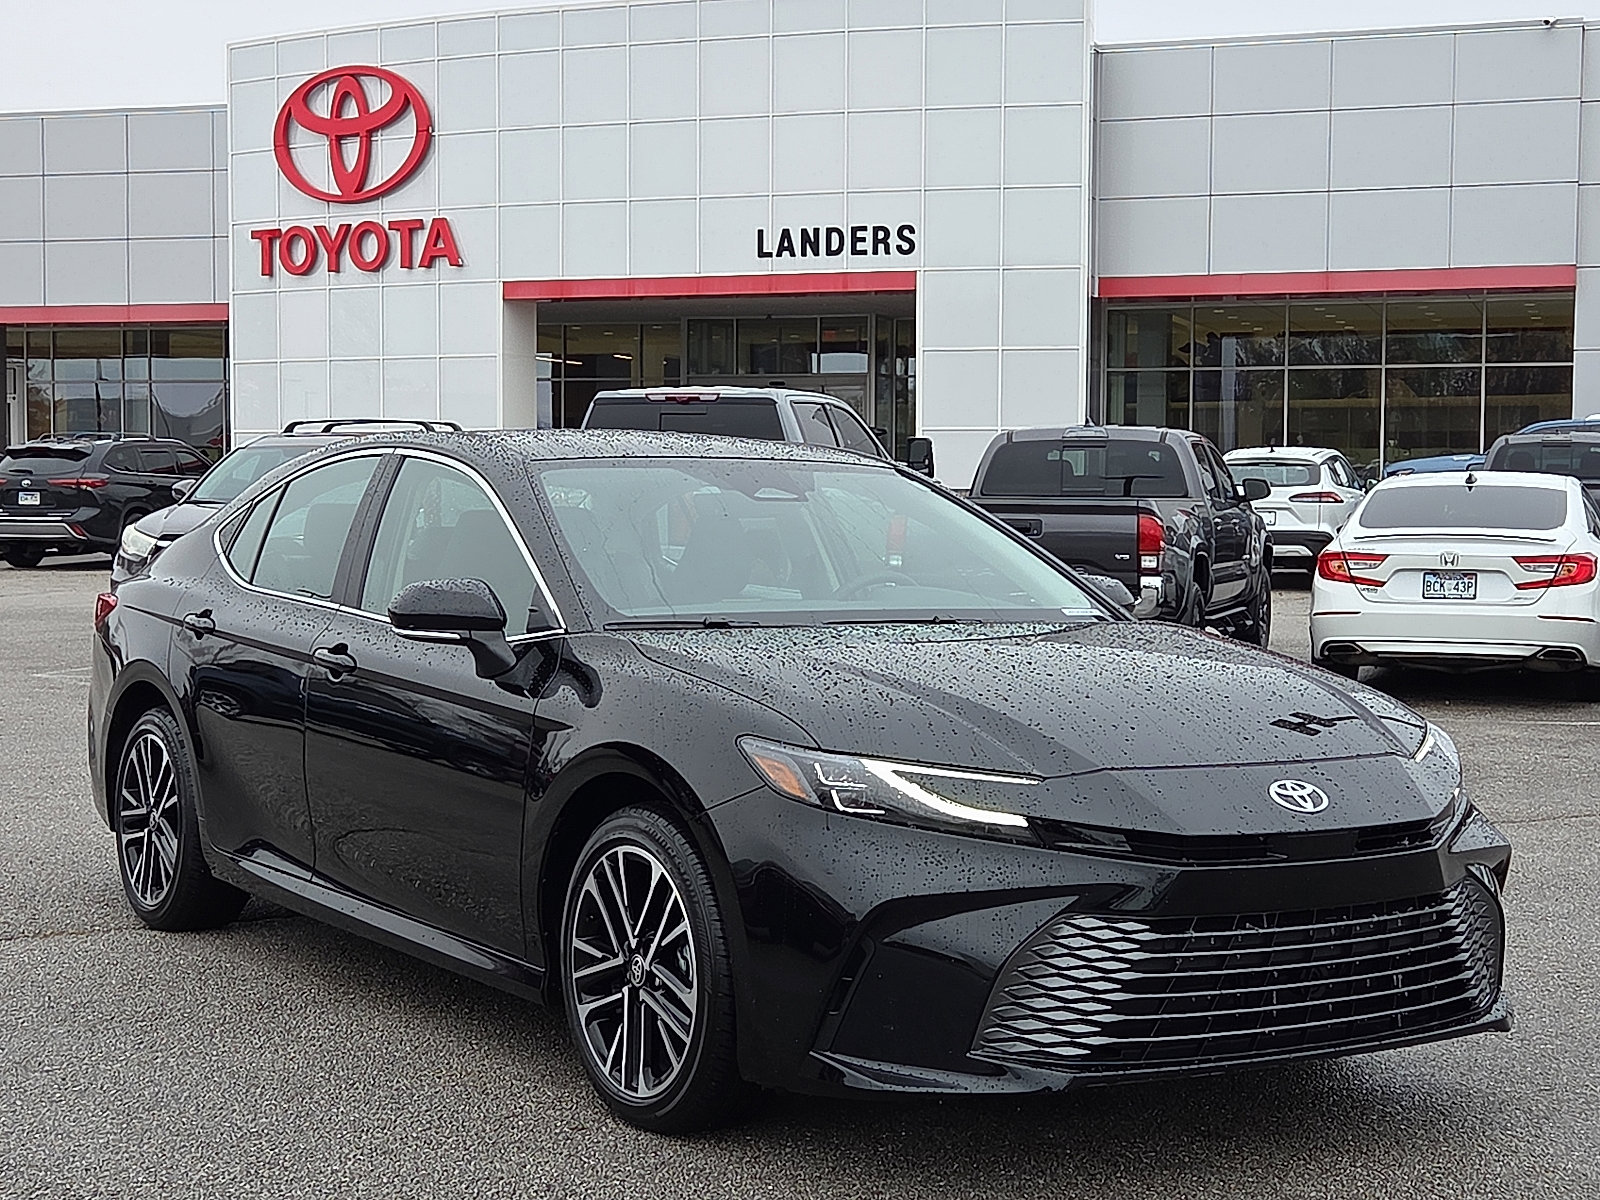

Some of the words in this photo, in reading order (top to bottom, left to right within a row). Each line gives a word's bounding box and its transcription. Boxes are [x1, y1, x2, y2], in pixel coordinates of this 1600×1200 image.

[251, 217, 463, 277] TOYOTA
[757, 224, 916, 258] LANDERS
[1425, 580, 1446, 592] BCK
[1453, 581, 1473, 593] 43P
